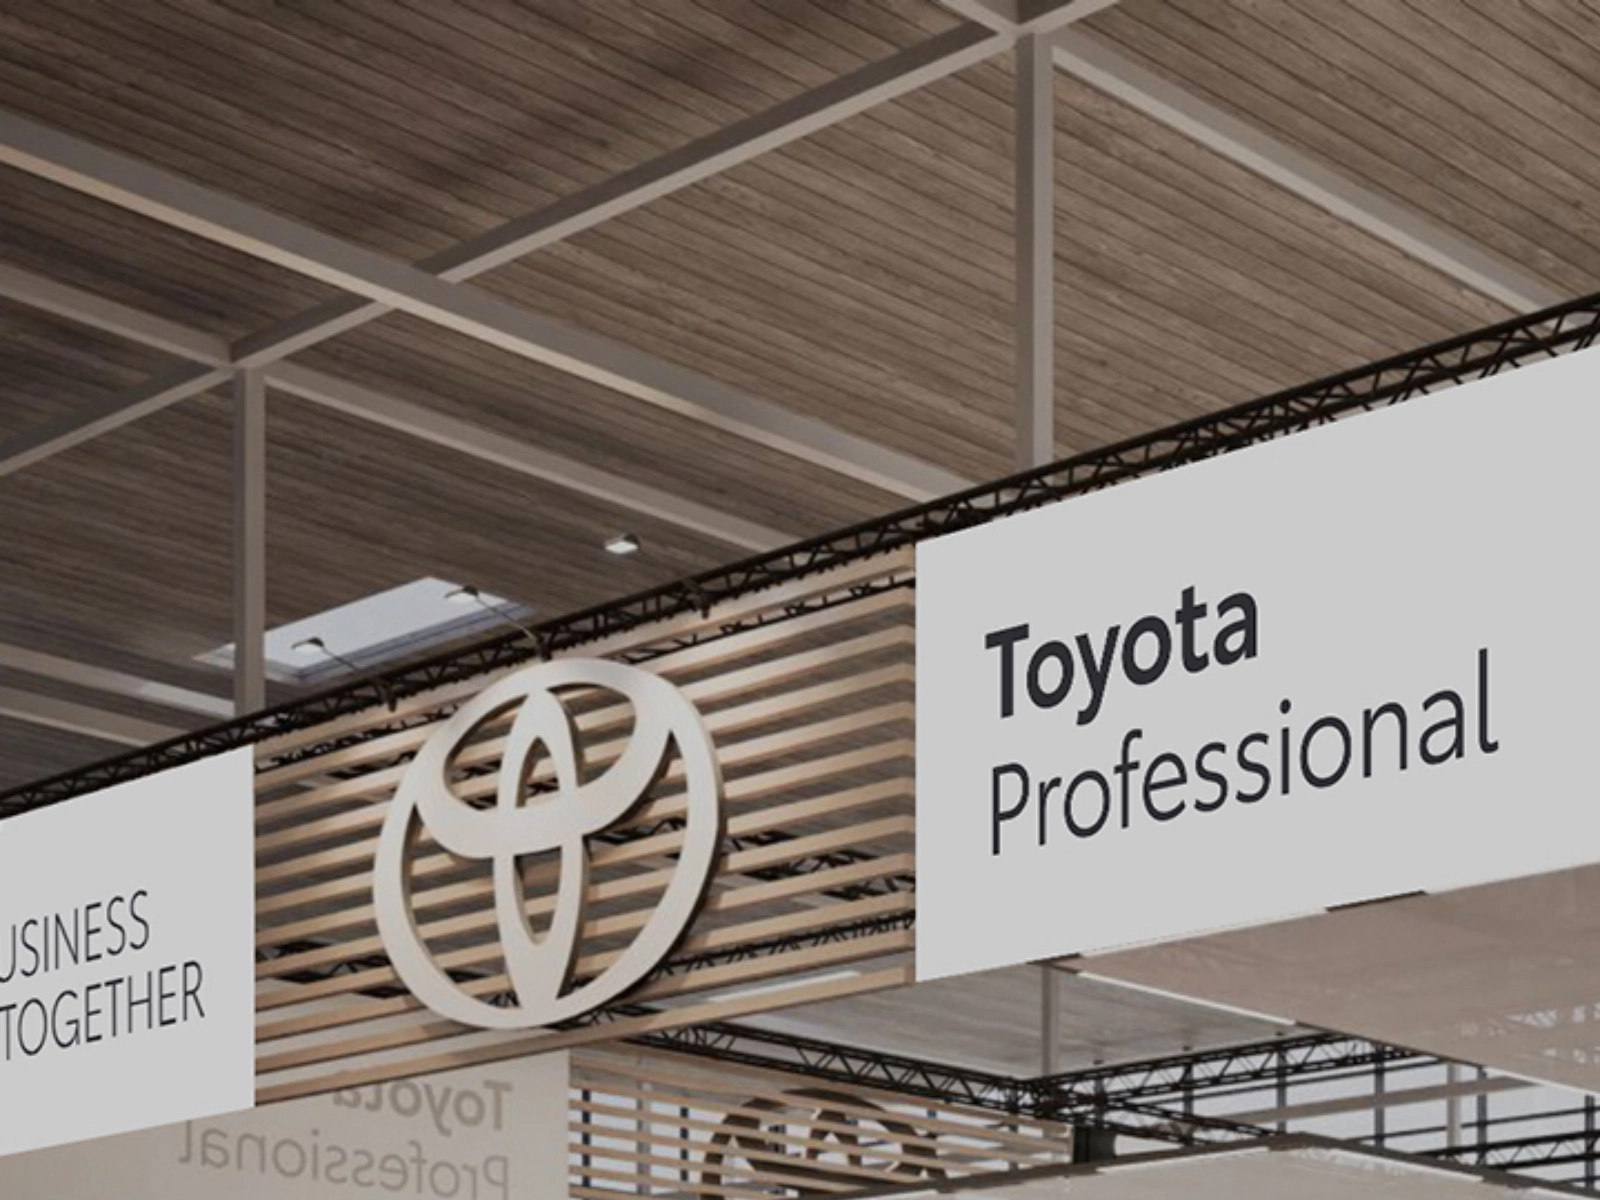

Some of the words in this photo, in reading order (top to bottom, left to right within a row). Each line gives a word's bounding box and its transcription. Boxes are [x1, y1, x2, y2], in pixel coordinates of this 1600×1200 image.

[985, 585, 1259, 726] Toyota
[992, 647, 1499, 856] Professional
[0, 889, 150, 983] USINESS
[0, 960, 205, 1061] TOGETHER
